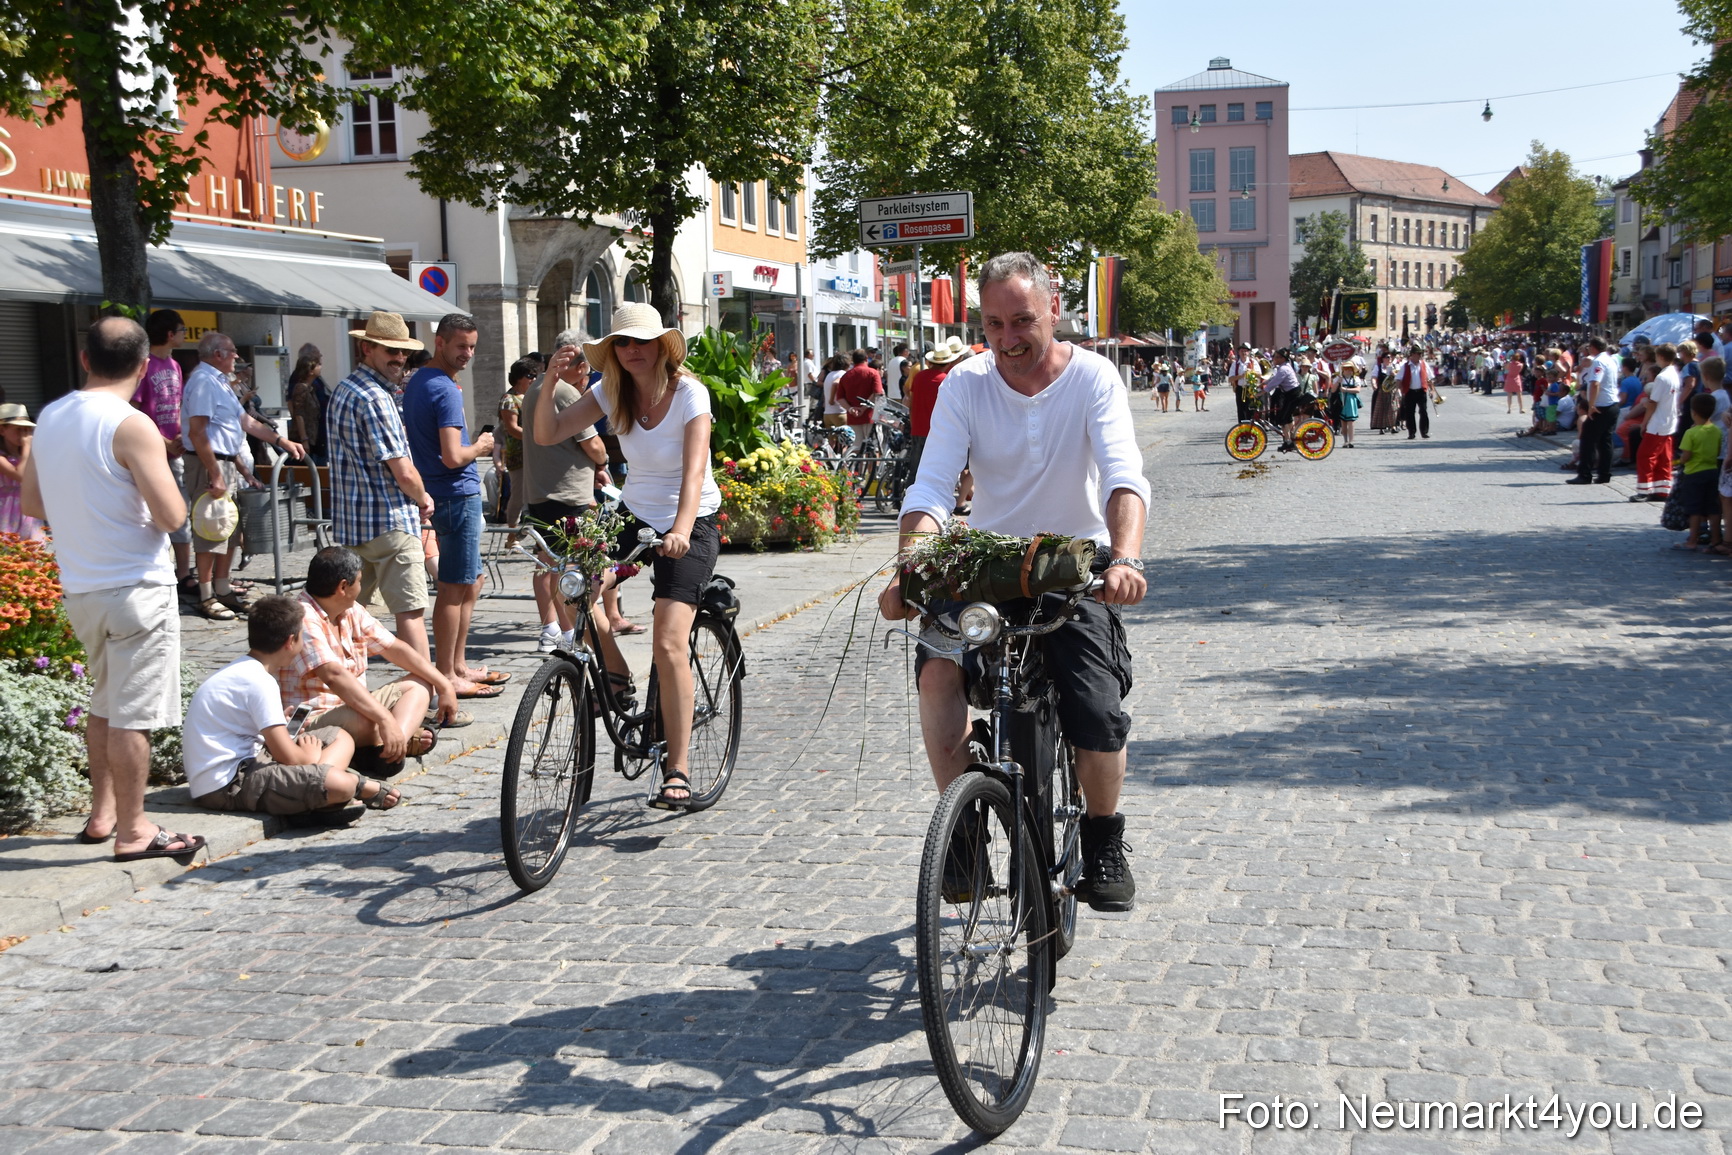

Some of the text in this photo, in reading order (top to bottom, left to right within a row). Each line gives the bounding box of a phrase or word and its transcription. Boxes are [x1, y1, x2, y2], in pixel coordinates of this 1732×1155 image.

[877, 201, 950, 216] Parkleitsystem
[904, 223, 951, 235] Rosengasse
[885, 263, 913, 275] Rosengasse
